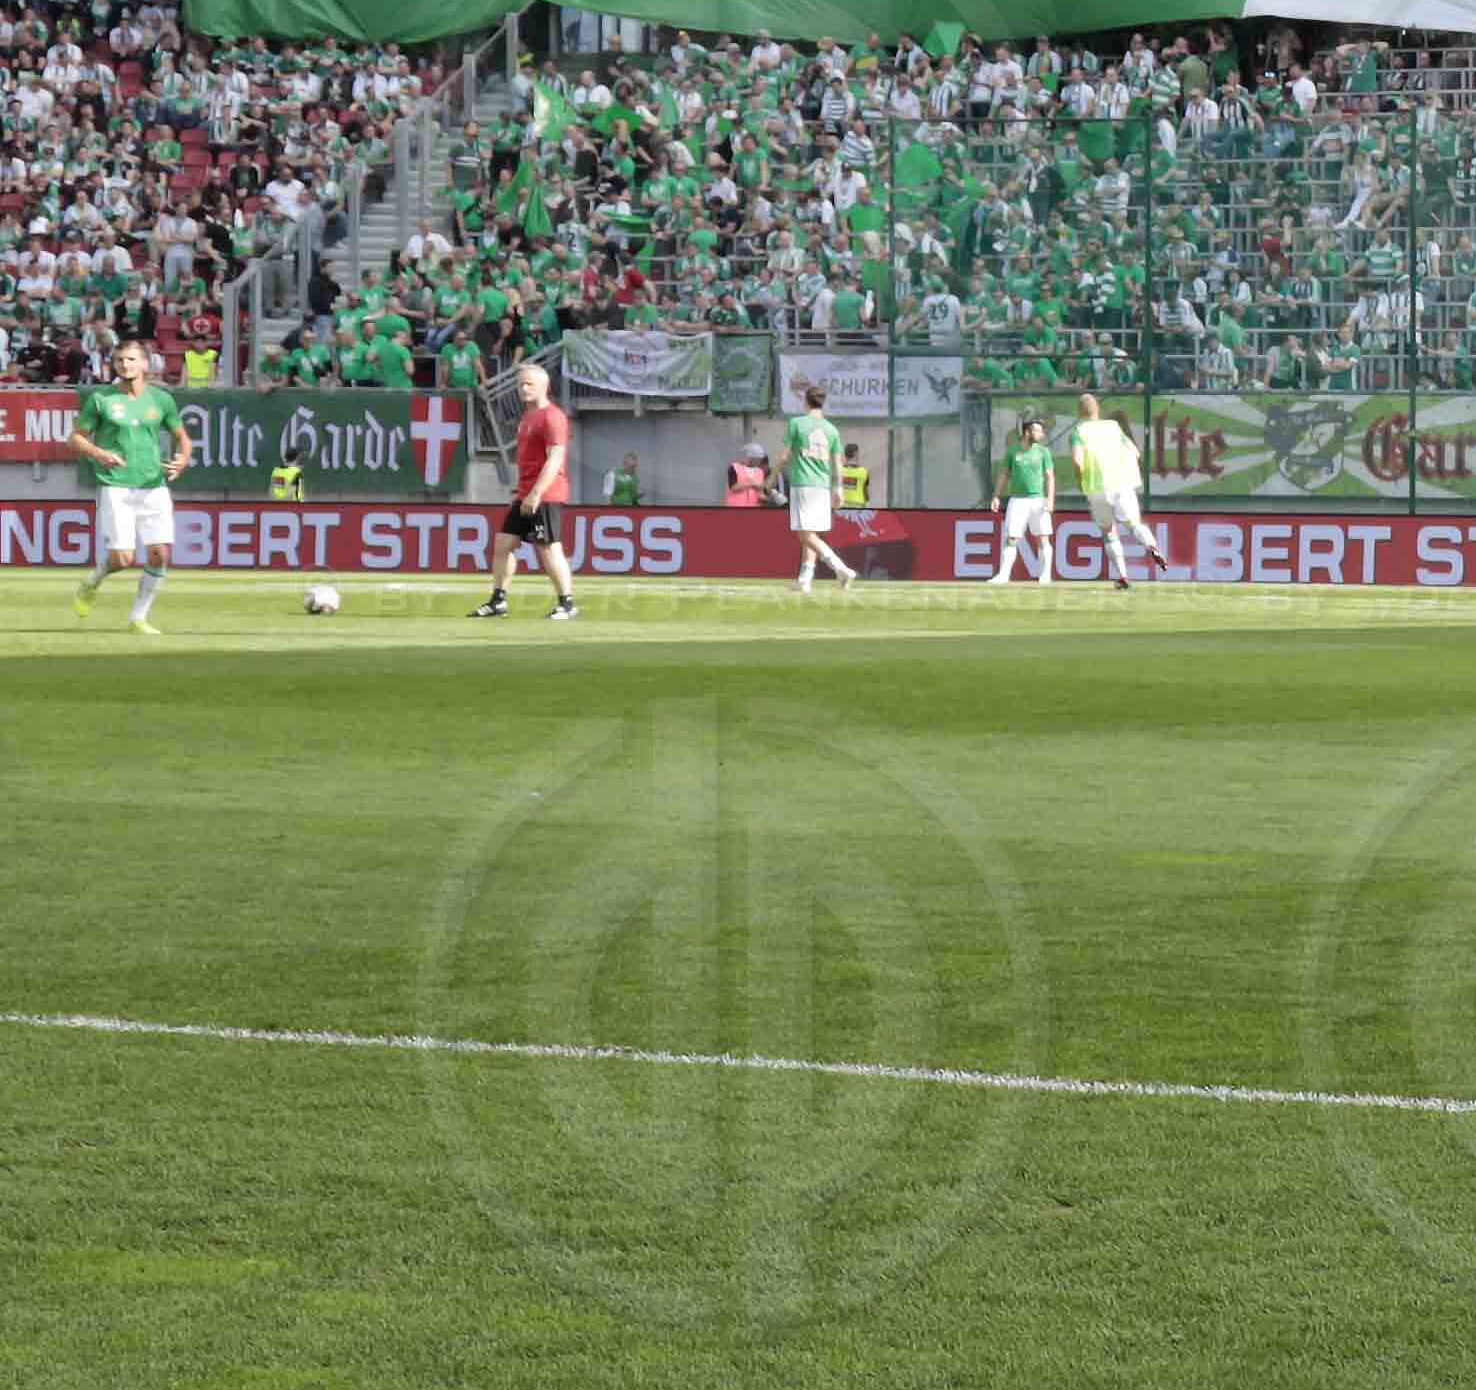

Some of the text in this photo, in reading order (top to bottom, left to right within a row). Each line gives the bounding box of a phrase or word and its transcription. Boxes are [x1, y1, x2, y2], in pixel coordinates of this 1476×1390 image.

[178, 403, 405, 474] Alte Garde
[0, 509, 340, 567] NGBERT
